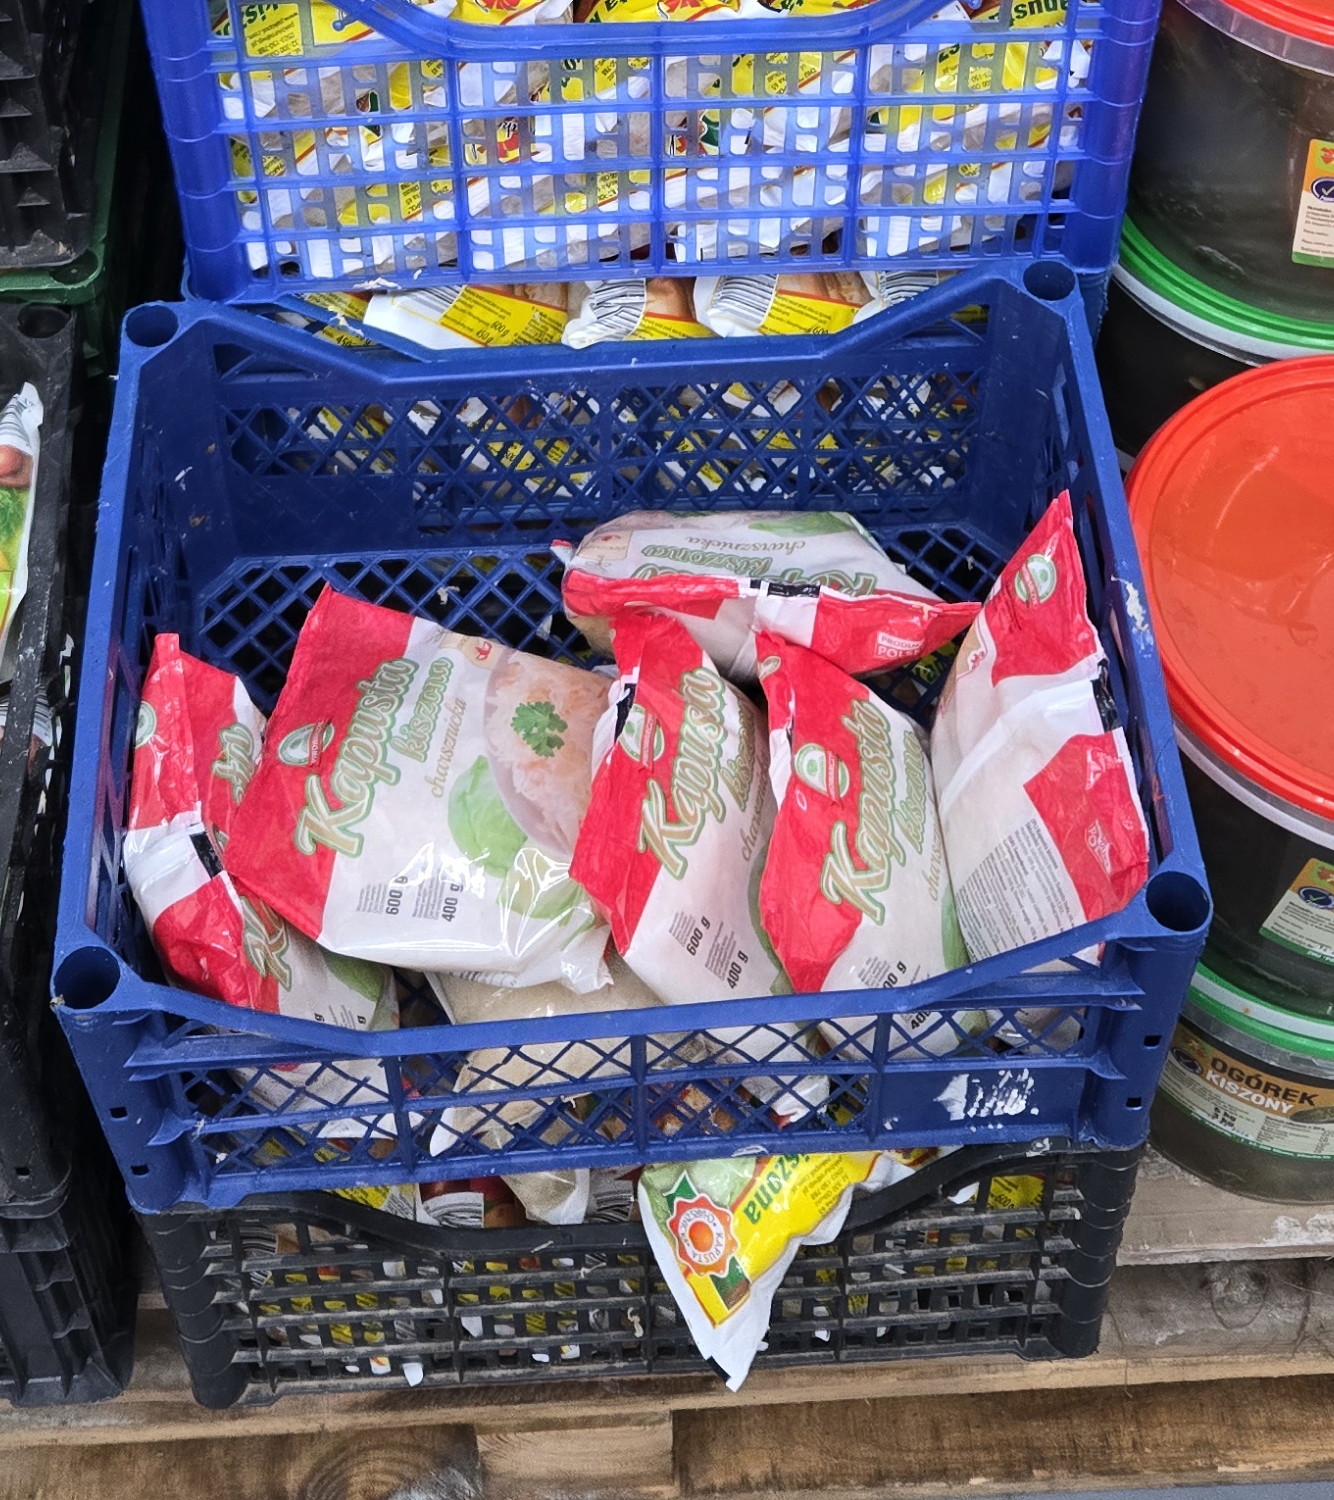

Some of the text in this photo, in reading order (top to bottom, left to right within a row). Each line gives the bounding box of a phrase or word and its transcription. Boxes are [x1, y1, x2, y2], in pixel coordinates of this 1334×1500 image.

[640, 544, 774, 576] kiszona
[388, 656, 455, 764] kiszona
[295, 656, 420, 860] Kapusta
[424, 695, 469, 799] charsznicka
[820, 698, 907, 927] Kapusta
[386, 887, 404, 916] 600
[442, 896, 460, 922] 400
[685, 928, 705, 957] 600
[726, 963, 744, 991] 400
[1204, 1069, 1295, 1116] KISZONY
[1210, 1056, 1320, 1108] OGÓREK
